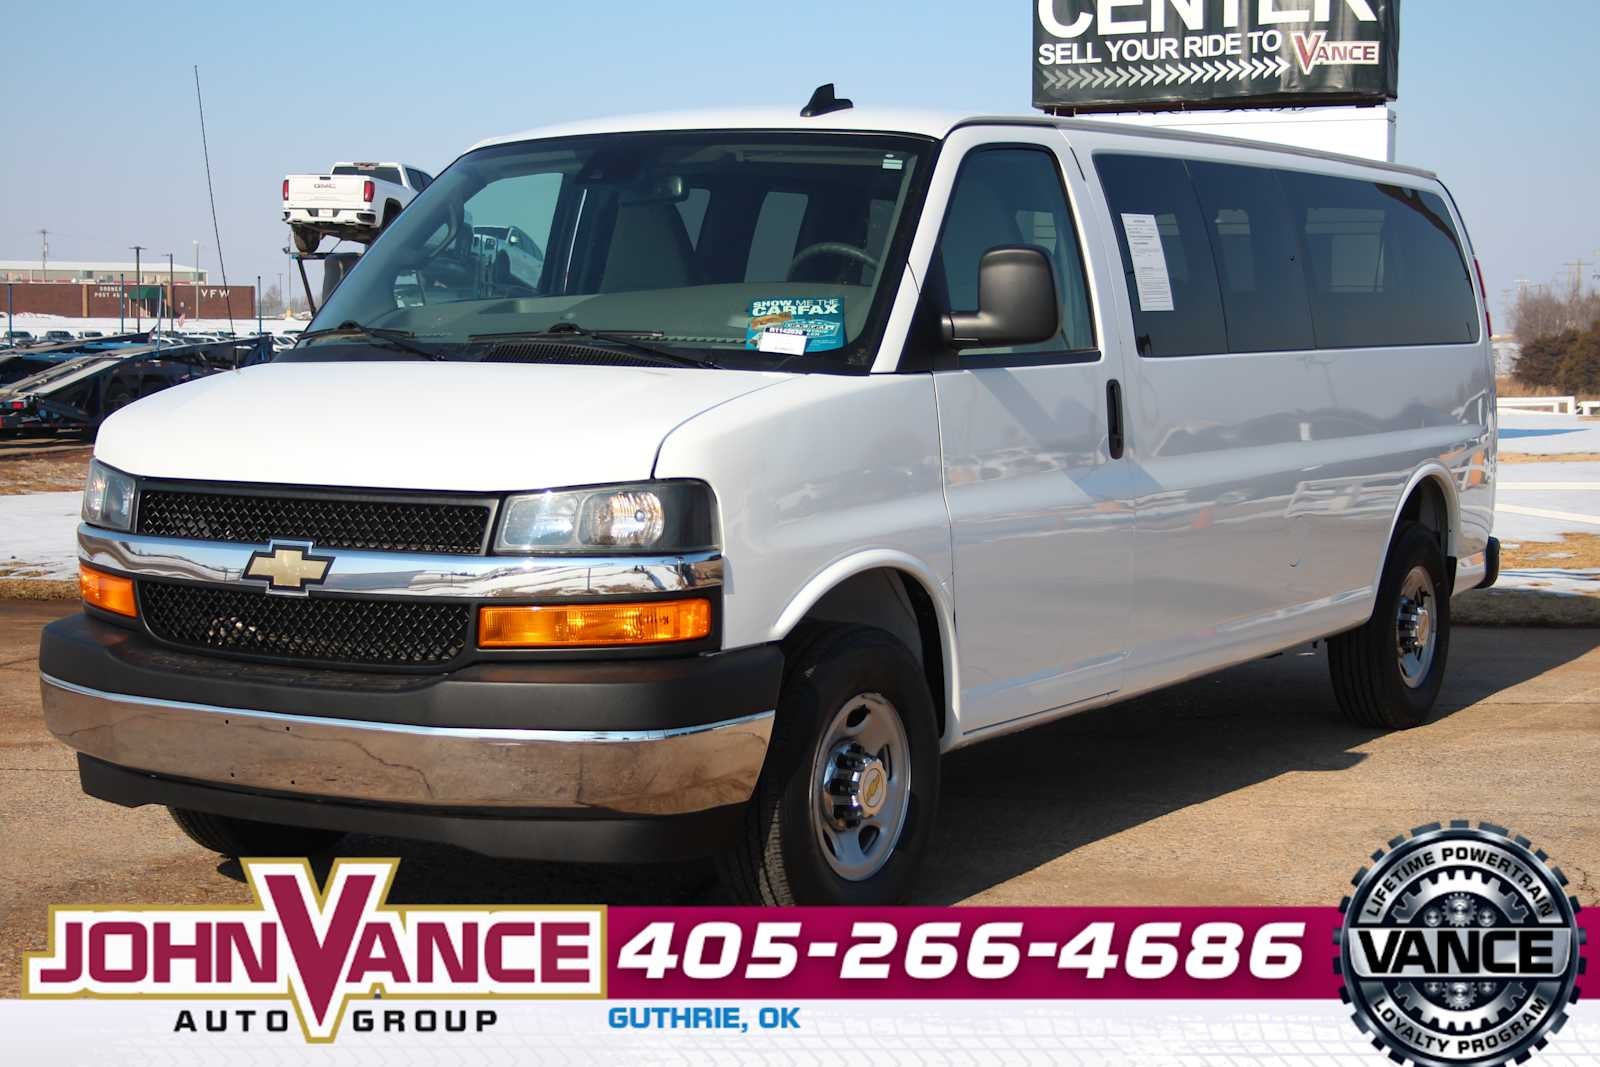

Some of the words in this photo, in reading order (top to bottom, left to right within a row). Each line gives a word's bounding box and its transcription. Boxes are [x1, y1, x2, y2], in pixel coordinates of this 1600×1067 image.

[1038, 42, 1102, 66] SELL
[1105, 36, 1180, 62] YOUR
[1183, 33, 1242, 58] RIDE
[1249, 29, 1283, 53] TO
[200, 289, 230, 299] VFW
[752, 304, 839, 317] CARFAX
